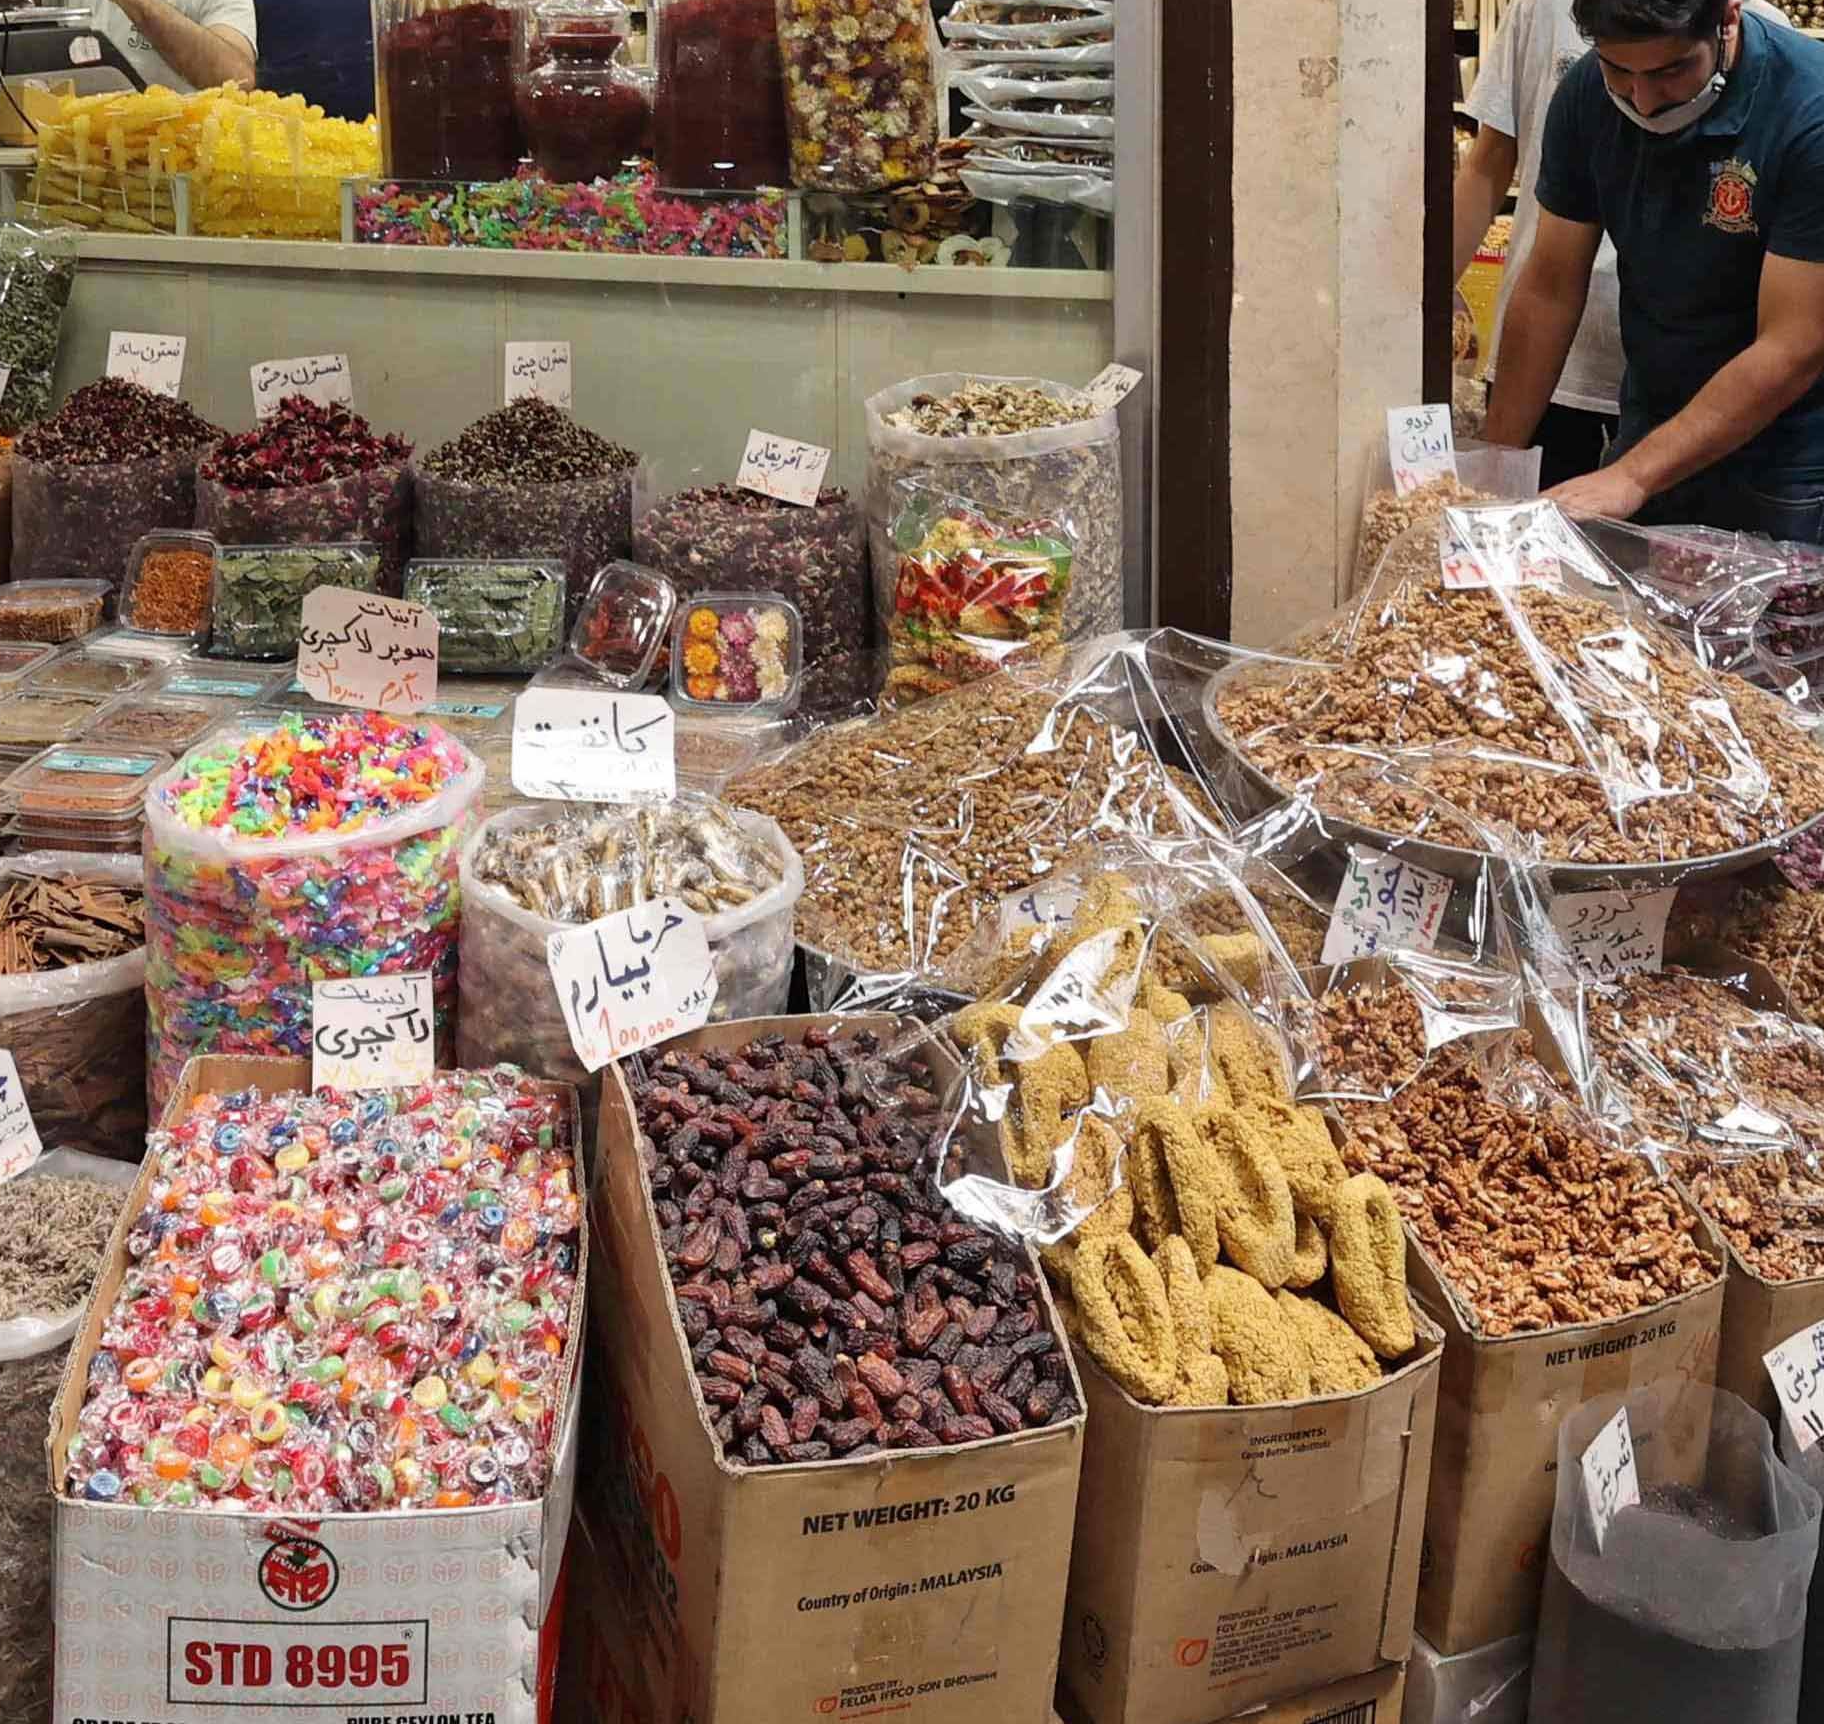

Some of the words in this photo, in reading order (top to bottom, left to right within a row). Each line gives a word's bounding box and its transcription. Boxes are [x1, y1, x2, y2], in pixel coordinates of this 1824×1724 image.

[626, 900, 683, 954] خرما
[1545, 1348, 1571, 1367] NET
[1576, 1333, 1637, 1358] WEIGHT:
[1639, 1328, 1656, 1345] 20
[1658, 1320, 1676, 1338] KG
[801, 1511, 852, 1536] NET
[852, 1499, 952, 1531] WEIGHT:
[954, 1490, 982, 1514] 20
[987, 1483, 1017, 1507] KG
[1285, 1532, 1349, 1560] MALAYSIA
[796, 1588, 850, 1612] Country
[852, 1585, 867, 1603] of
[868, 1579, 911, 1604] Origin
[919, 1561, 1003, 1592] MALAYSIA
[184, 1640, 273, 1687] STD
[284, 1643, 411, 1689] 8995
[840, 1693, 877, 1709] FELDA
[879, 1688, 915, 1704] IFFCO
[916, 1682, 942, 1697] SDN
